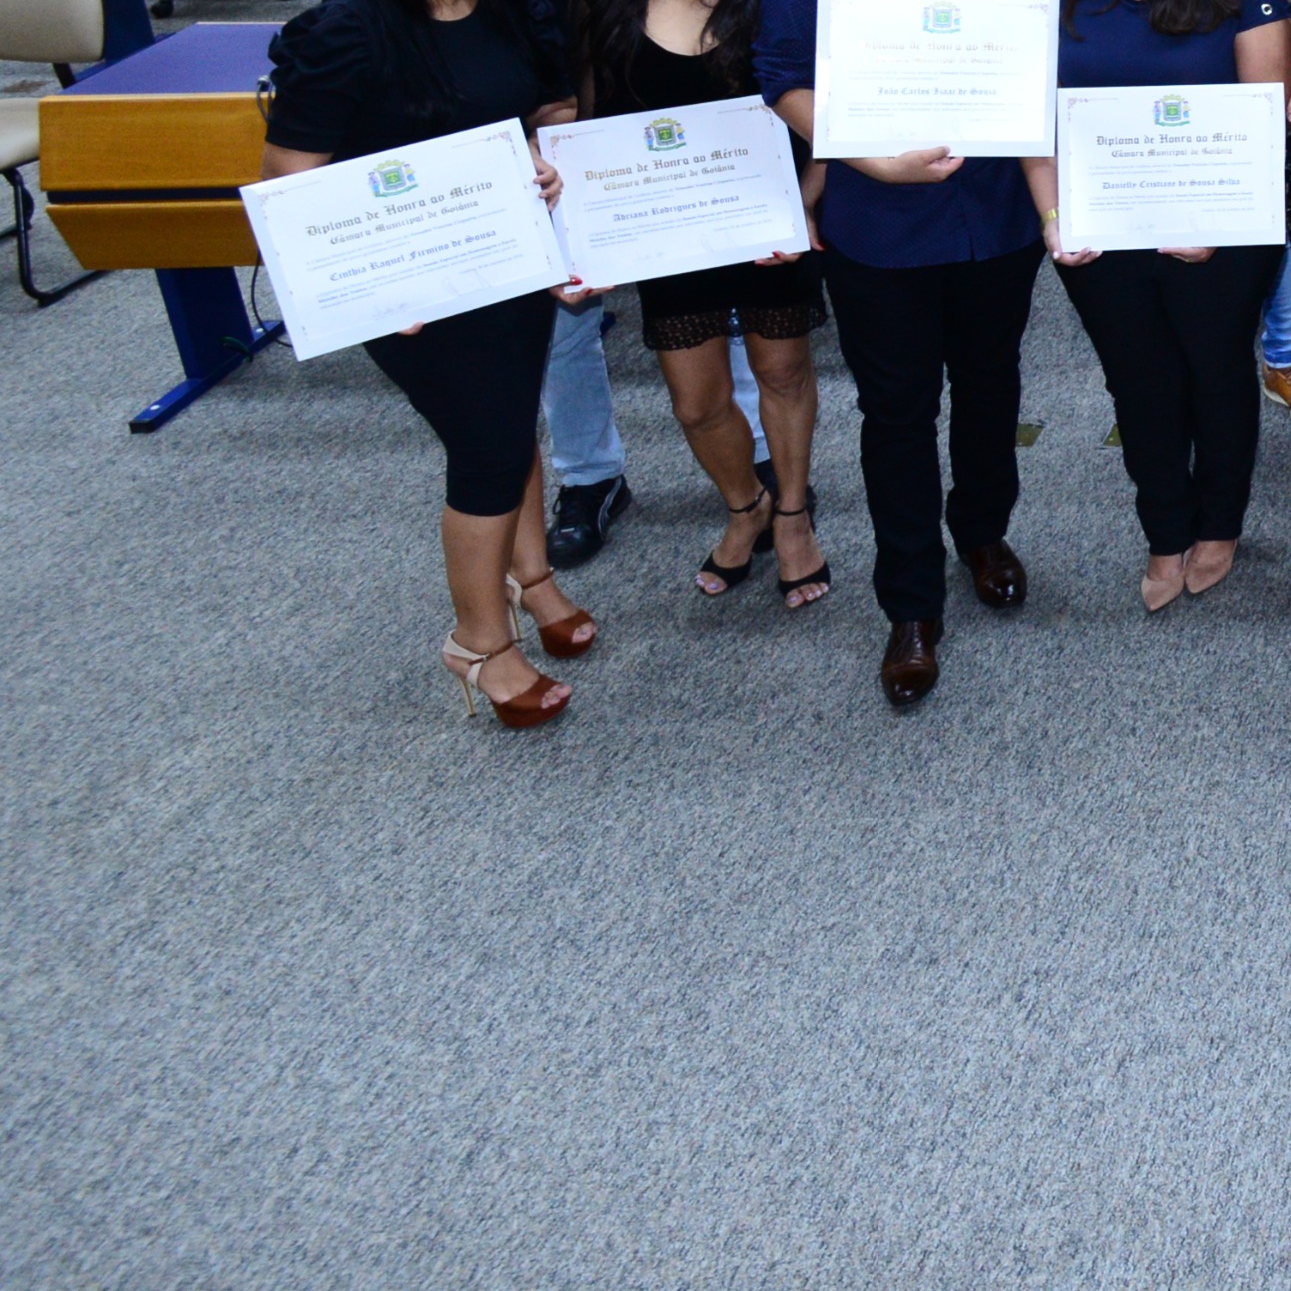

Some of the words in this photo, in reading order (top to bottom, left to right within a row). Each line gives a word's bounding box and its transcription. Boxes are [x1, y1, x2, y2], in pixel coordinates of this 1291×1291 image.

[1096, 135, 1140, 147] Diploma
[1143, 134, 1154, 144] de
[1158, 133, 1192, 143] Honra
[1211, 132, 1247, 142] Mérito
[584, 166, 632, 181] Diploma
[635, 162, 648, 172] de
[651, 157, 690, 170] Honra
[692, 154, 706, 163] ao
[710, 148, 748, 161] Mérito
[603, 180, 639, 191] Câmara
[642, 170, 686, 185] Municipal
[689, 169, 698, 177] de
[700, 164, 736, 175] Goiânia
[305, 216, 362, 236] Diploma
[364, 211, 380, 221] de
[383, 199, 426, 216] Honra
[429, 194, 445, 204] ao
[449, 181, 492, 199] Mérito
[329, 229, 371, 245] Câmara
[374, 213, 424, 233] Municipal
[426, 211, 437, 219] de
[440, 200, 479, 215] Goiânia
[612, 210, 648, 222] Adriana
[651, 202, 697, 215] Rodrigues
[710, 195, 739, 205] Sousa
[329, 266, 367, 281] Cinthia
[369, 254, 405, 270] Raquel
[408, 243, 449, 261] Firmino
[450, 239, 462, 247] de
[464, 230, 496, 244] Sousa
